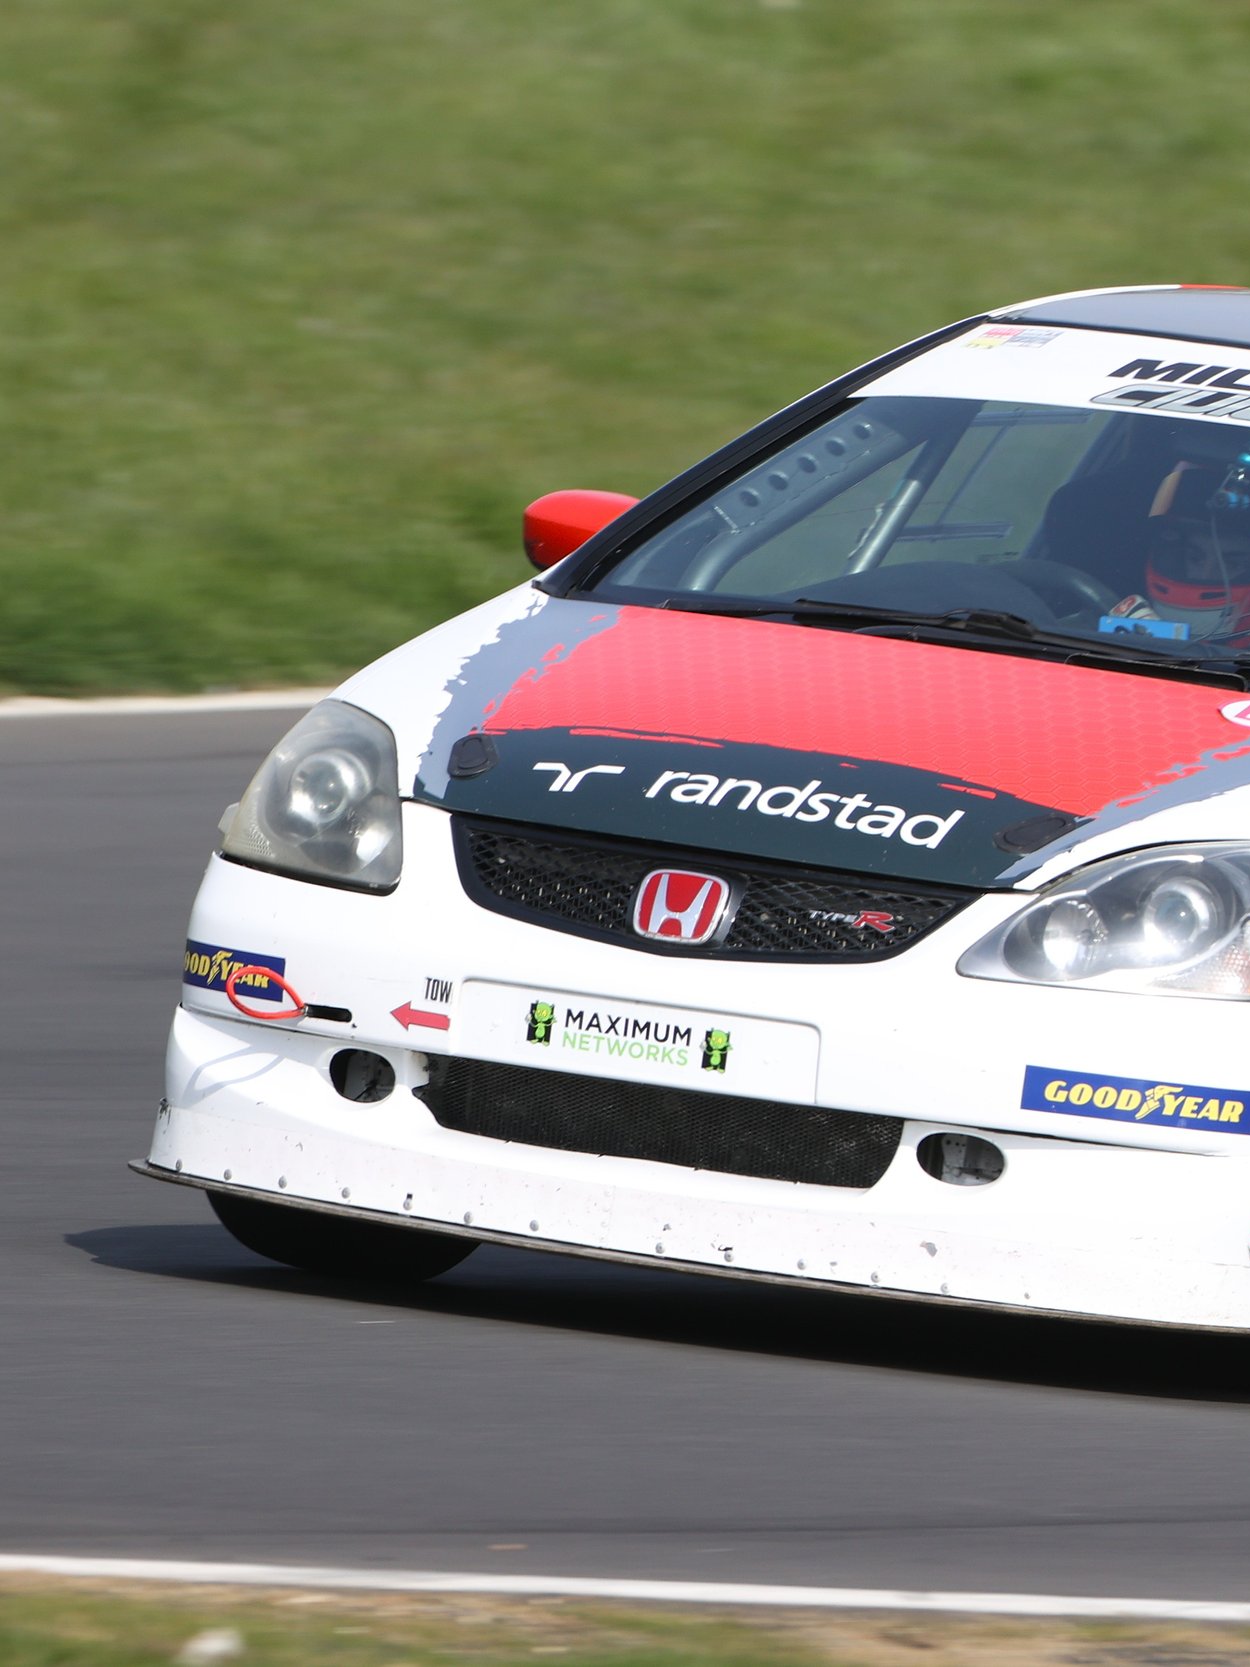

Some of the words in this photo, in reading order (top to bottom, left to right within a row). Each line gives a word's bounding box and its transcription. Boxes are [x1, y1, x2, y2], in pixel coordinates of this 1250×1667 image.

[644, 768, 965, 850] randstad
[851, 910, 896, 933] R
[424, 977, 453, 1004] TOW
[565, 1008, 692, 1047] MAXIMUM
[562, 1031, 689, 1067] NETWORKS
